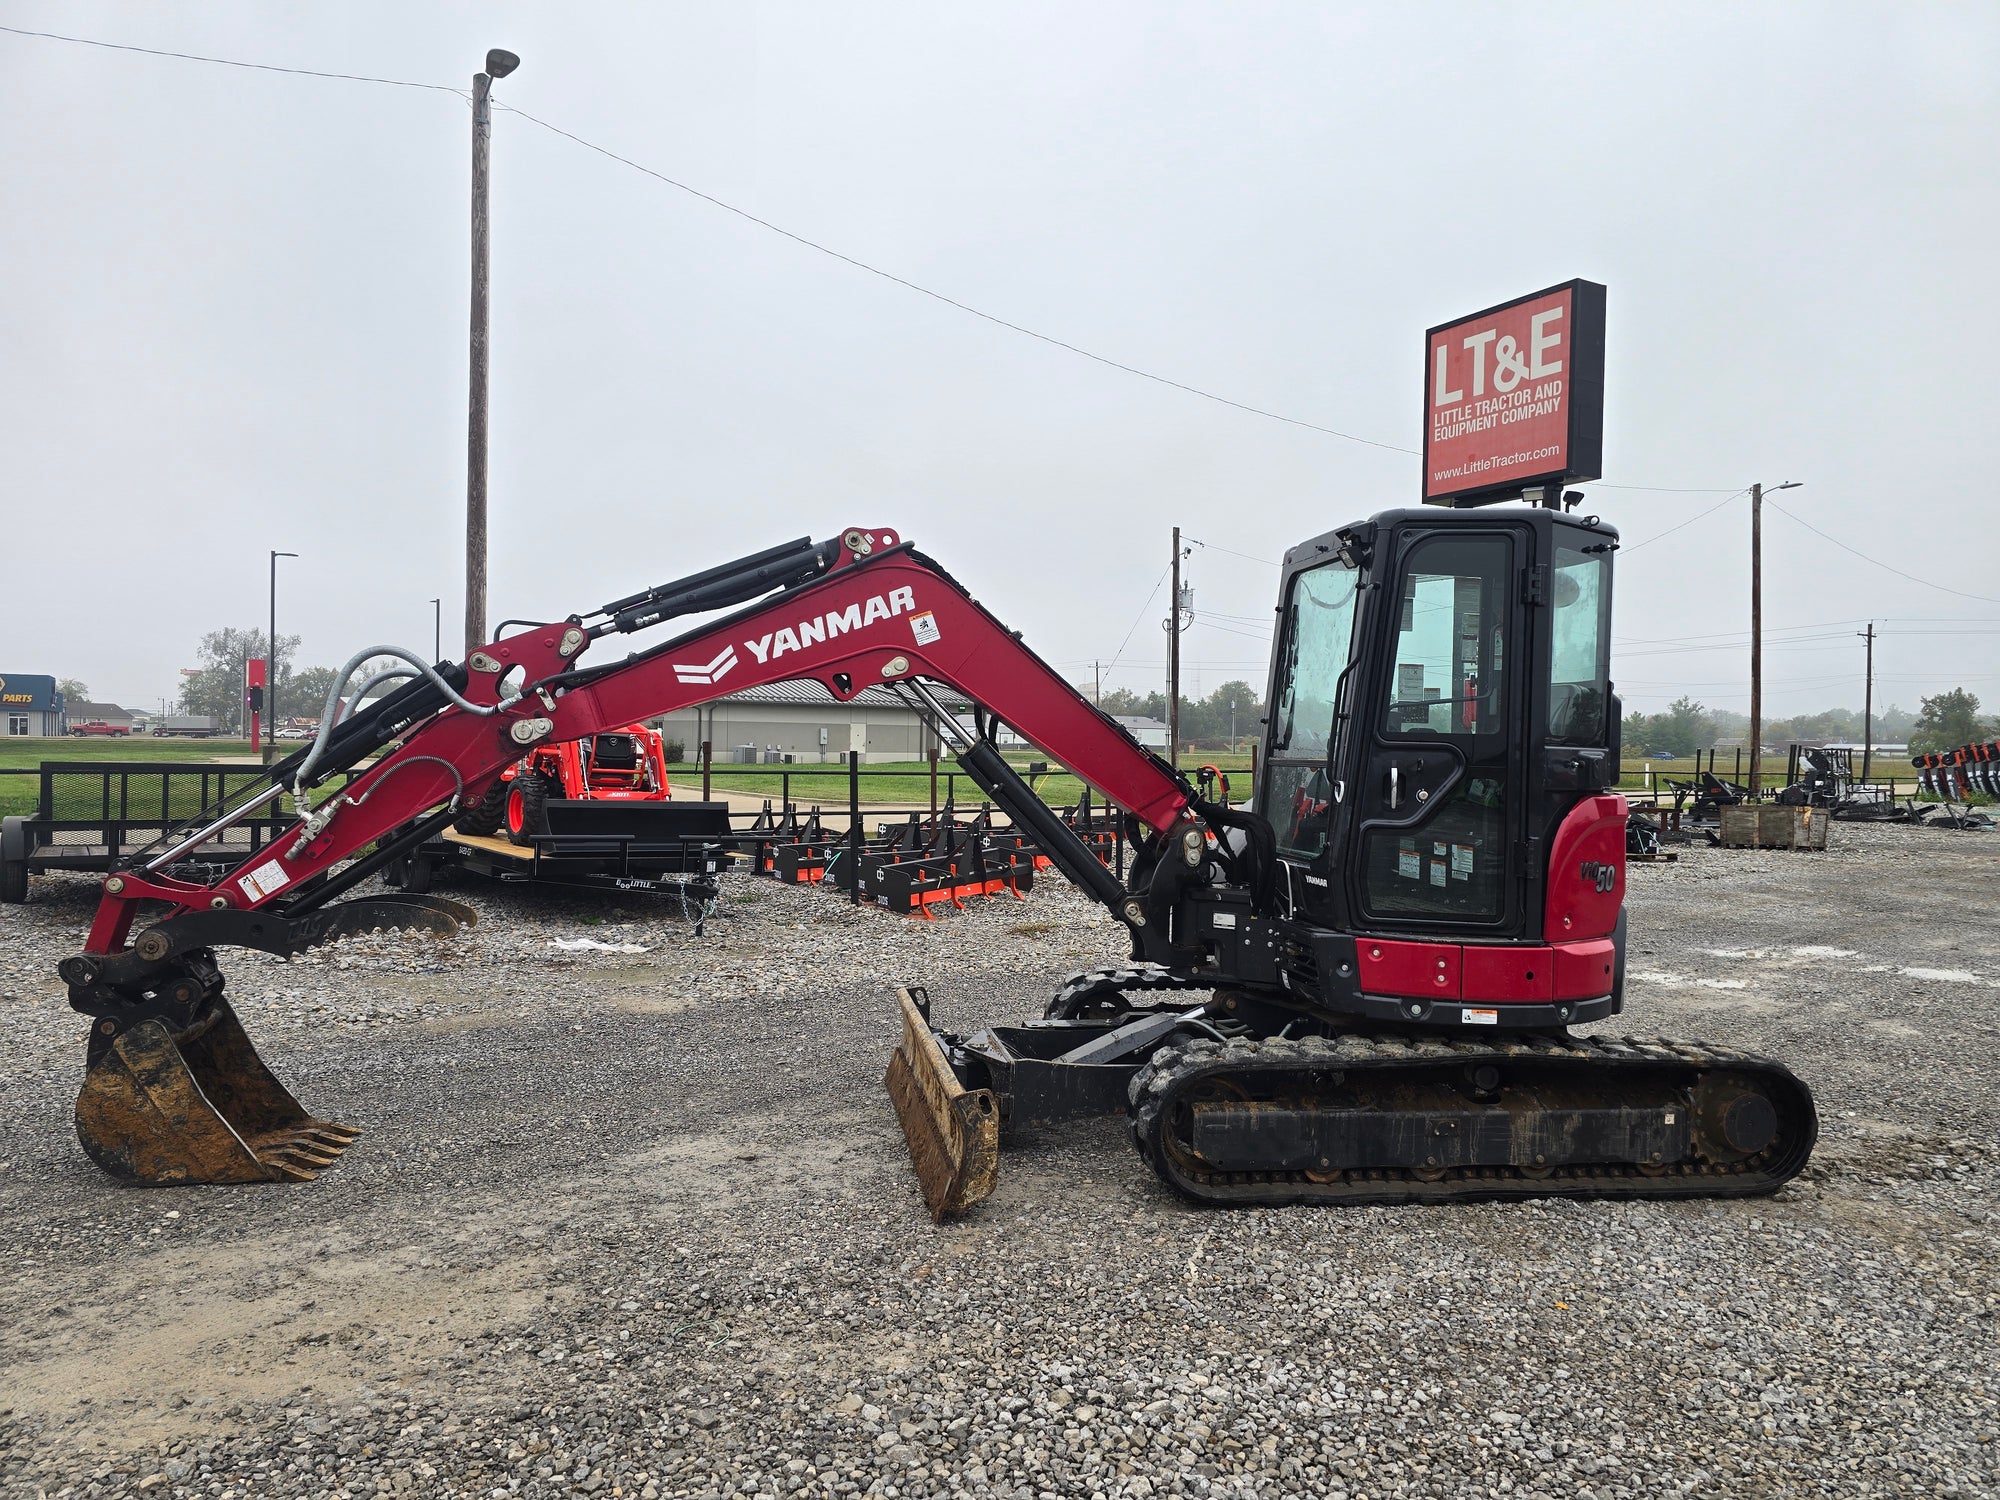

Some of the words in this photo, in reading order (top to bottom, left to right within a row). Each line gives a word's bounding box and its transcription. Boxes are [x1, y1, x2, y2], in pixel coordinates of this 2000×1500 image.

[1435, 306, 1563, 407] LT&E
[1434, 405, 1472, 428] LITTLE
[1475, 389, 1531, 417] TRACTOR
[1535, 380, 1562, 402] AND
[1434, 413, 1498, 442] EQUIPMENT
[1501, 397, 1561, 425] COMPANY
[1434, 445, 1559, 481] www.LittleTractor.com
[744, 585, 916, 664] YANMAR
[2, 694, 33, 703] PARTS
[1305, 874, 1328, 888] YANMAR
